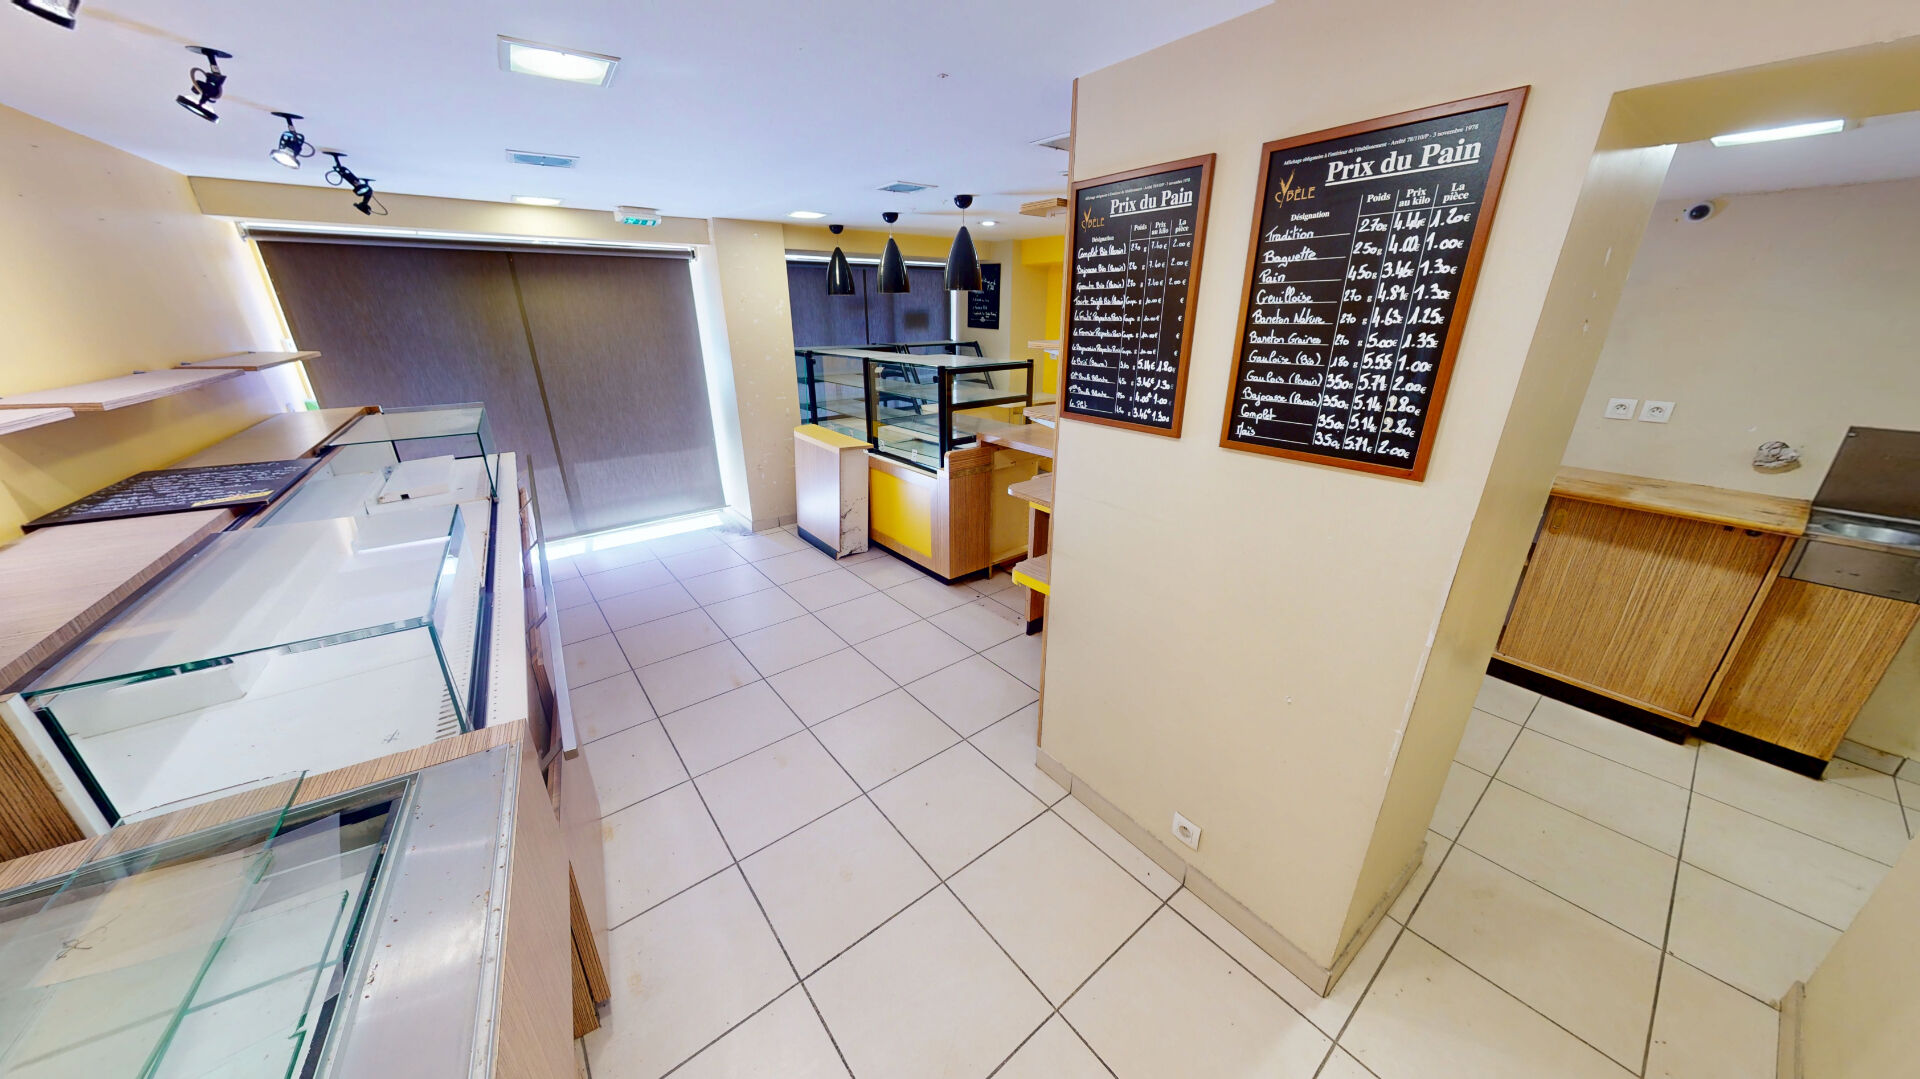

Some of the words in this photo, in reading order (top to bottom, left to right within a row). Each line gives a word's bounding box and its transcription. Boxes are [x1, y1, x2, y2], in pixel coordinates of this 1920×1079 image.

[1437, 128, 1464, 136] novembre
[1326, 156, 1375, 182] Prix
[1381, 151, 1412, 174] du
[1419, 138, 1482, 168] Pain
[1406, 188, 1428, 198] Prix
[1451, 182, 1466, 192] La
[1110, 197, 1137, 215] Prix
[1140, 194, 1158, 210] du
[1160, 187, 1193, 207] Pain
[1366, 192, 1392, 203] Poids
[1412, 196, 1431, 205] kilo
[1442, 190, 1470, 204] pièce
[1398, 200, 1410, 208] au
[1178, 218, 1187, 226] La
[1290, 210, 1330, 222] Désignation
[1133, 224, 1148, 232] Poids
[1155, 220, 1166, 228] Prix
[1265, 224, 1314, 242] Tradition
[1358, 217, 1388, 232] 270g
[1430, 207, 1472, 228] 1.20€
[1078, 246, 1098, 262] Complet
[1262, 246, 1318, 268] Baguette
[1352, 242, 1382, 256] 250g
[1426, 232, 1464, 250] 1.00€
[1259, 268, 1286, 284] Pain
[1348, 264, 1377, 281] 450g
[1420, 258, 1458, 277] 1.30€
[1294, 306, 1326, 324] Nature
[1248, 349, 1292, 364] Gauloise
[1240, 404, 1278, 424] Complet
